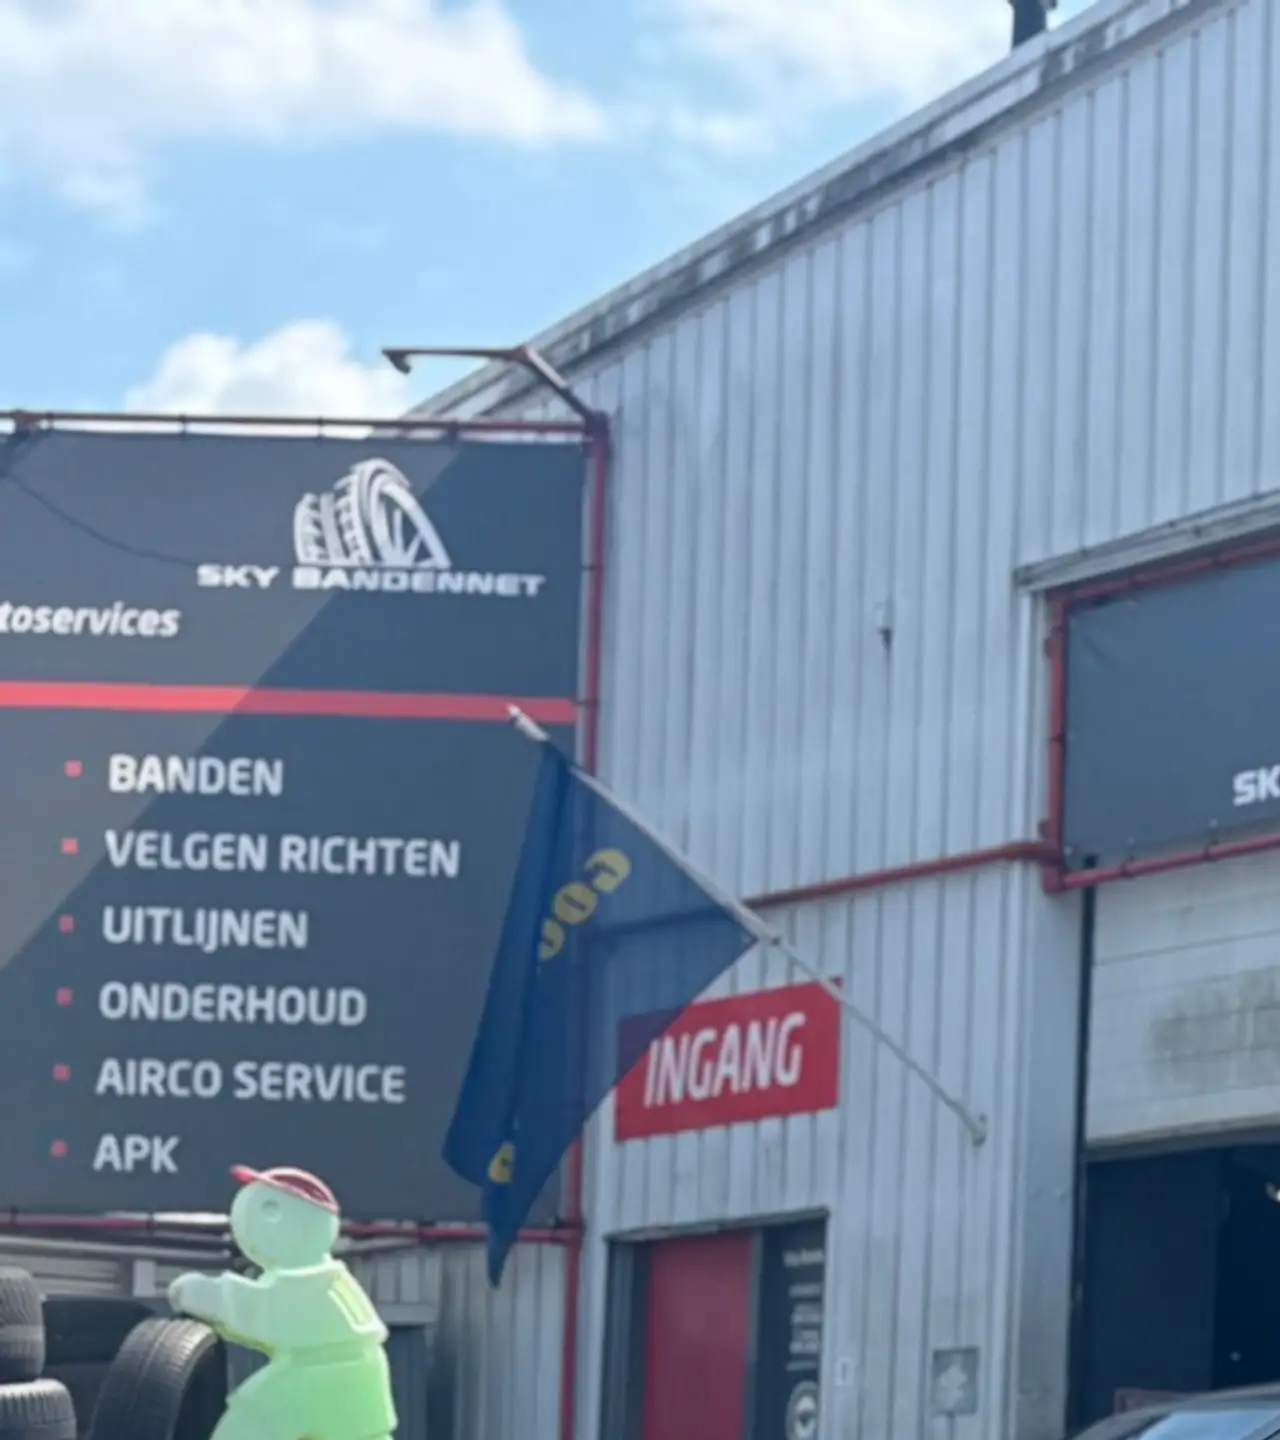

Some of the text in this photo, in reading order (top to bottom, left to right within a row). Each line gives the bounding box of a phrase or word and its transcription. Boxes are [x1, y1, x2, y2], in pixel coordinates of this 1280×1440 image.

[197, 563, 548, 597] SKY BANDENNET
[107, 754, 285, 797] BANDEN
[104, 831, 461, 879] VELGEN RICHTEN
[102, 907, 309, 953] UITLIJNEN
[98, 981, 367, 1027] ONDERHOUD
[95, 1058, 406, 1104] AIRCO SERVICE
[643, 1011, 805, 1110] INGANG
[92, 1134, 180, 1173] APK
